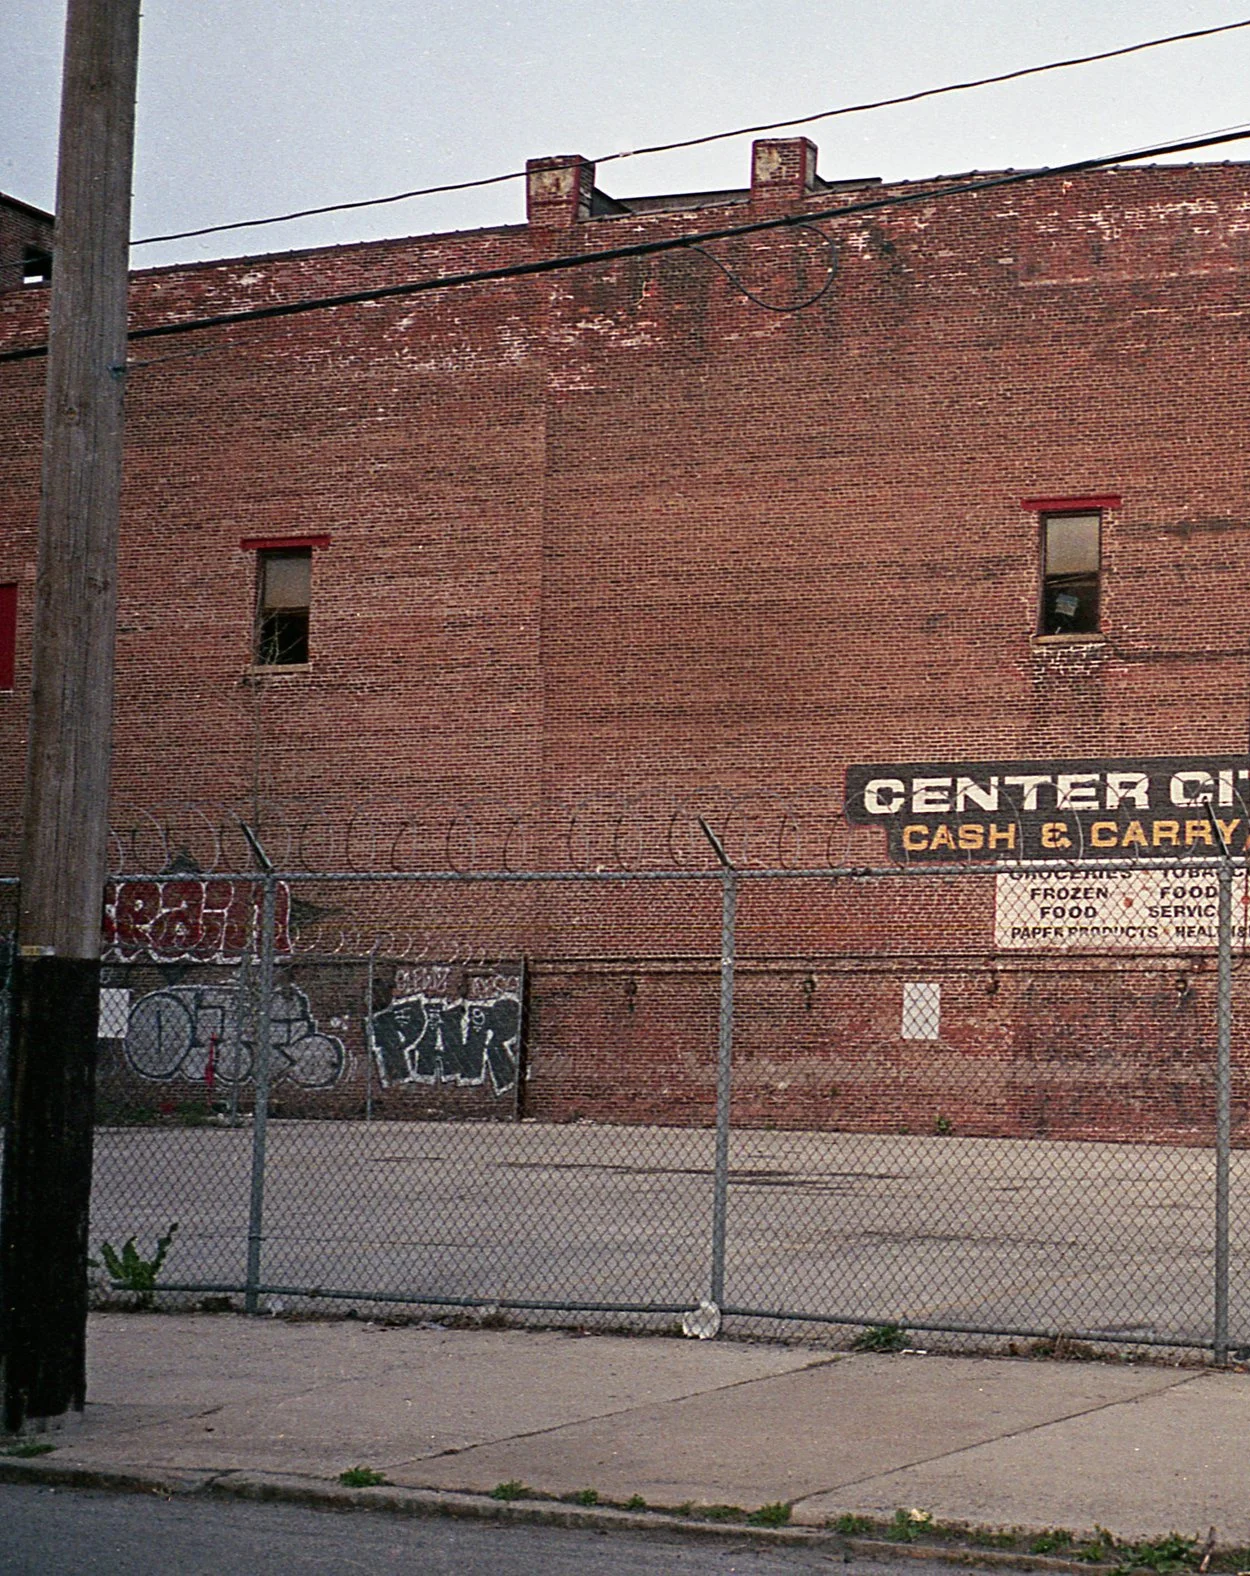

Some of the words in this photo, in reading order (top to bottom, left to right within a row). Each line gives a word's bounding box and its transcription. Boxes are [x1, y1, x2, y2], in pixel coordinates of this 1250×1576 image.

[863, 771, 1151, 816] CENTER
[901, 822, 1017, 852] CASH
[1040, 821, 1073, 850] &
[1030, 886, 1110, 901] FROZEN
[1160, 885, 1218, 899] FOOD
[1039, 905, 1099, 920] FOOD
[1149, 904, 1217, 918] SERVIC
